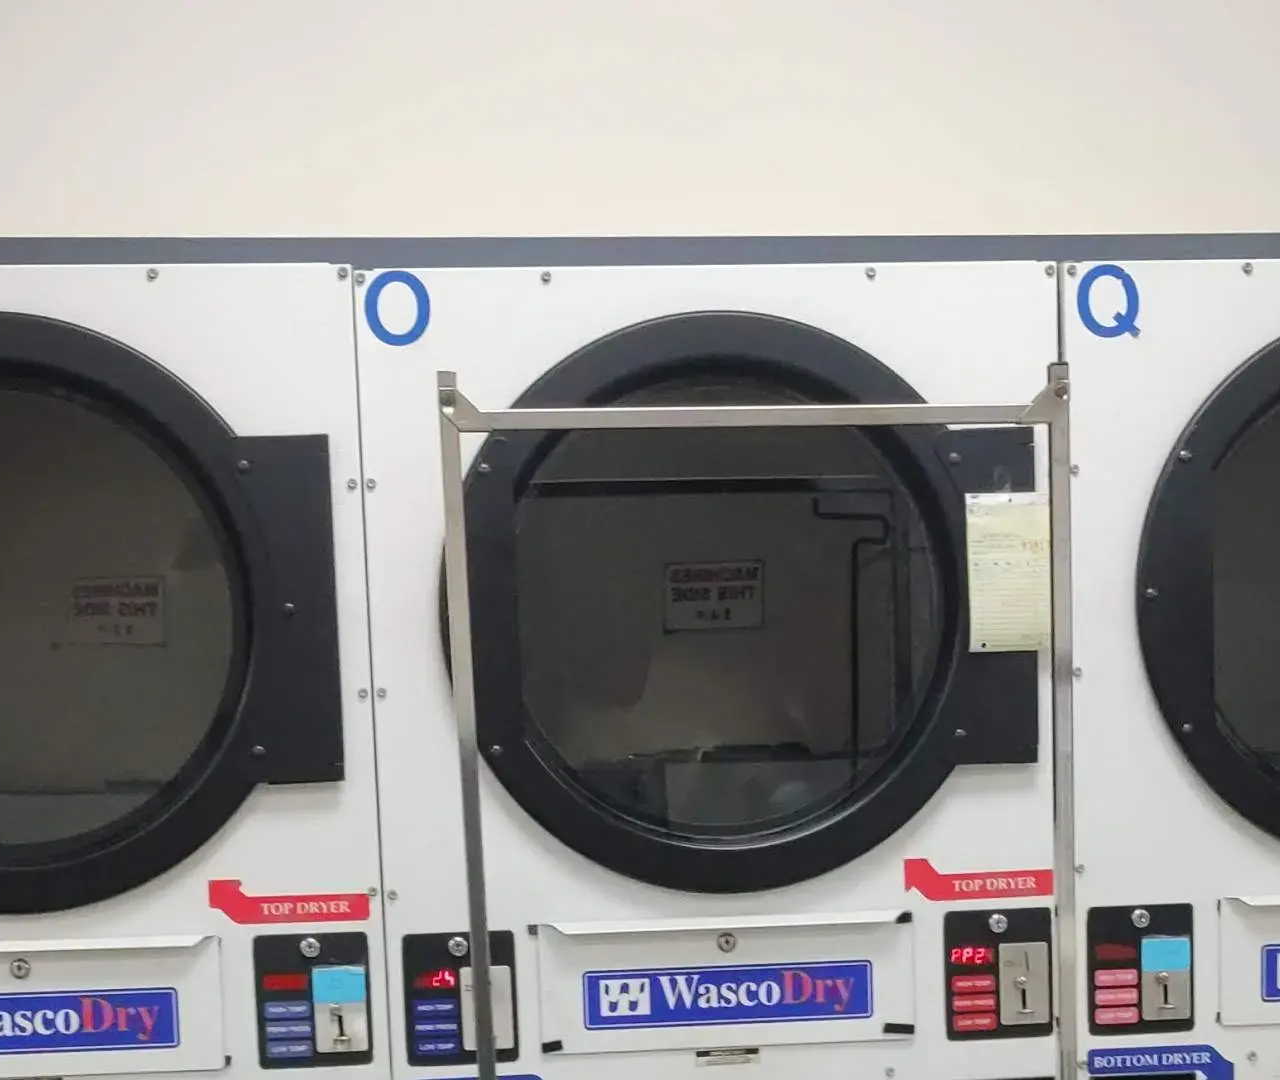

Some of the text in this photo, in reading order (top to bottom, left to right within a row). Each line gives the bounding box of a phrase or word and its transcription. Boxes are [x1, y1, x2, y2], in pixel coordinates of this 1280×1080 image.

[364, 270, 431, 346] O
[1077, 264, 1140, 338] Q
[952, 877, 1037, 892] TOP DRYER
[260, 901, 351, 915] TOP DRYER
[657, 970, 855, 1013] WascoDry
[1094, 1051, 1212, 1068] BOTTOM DRYER
